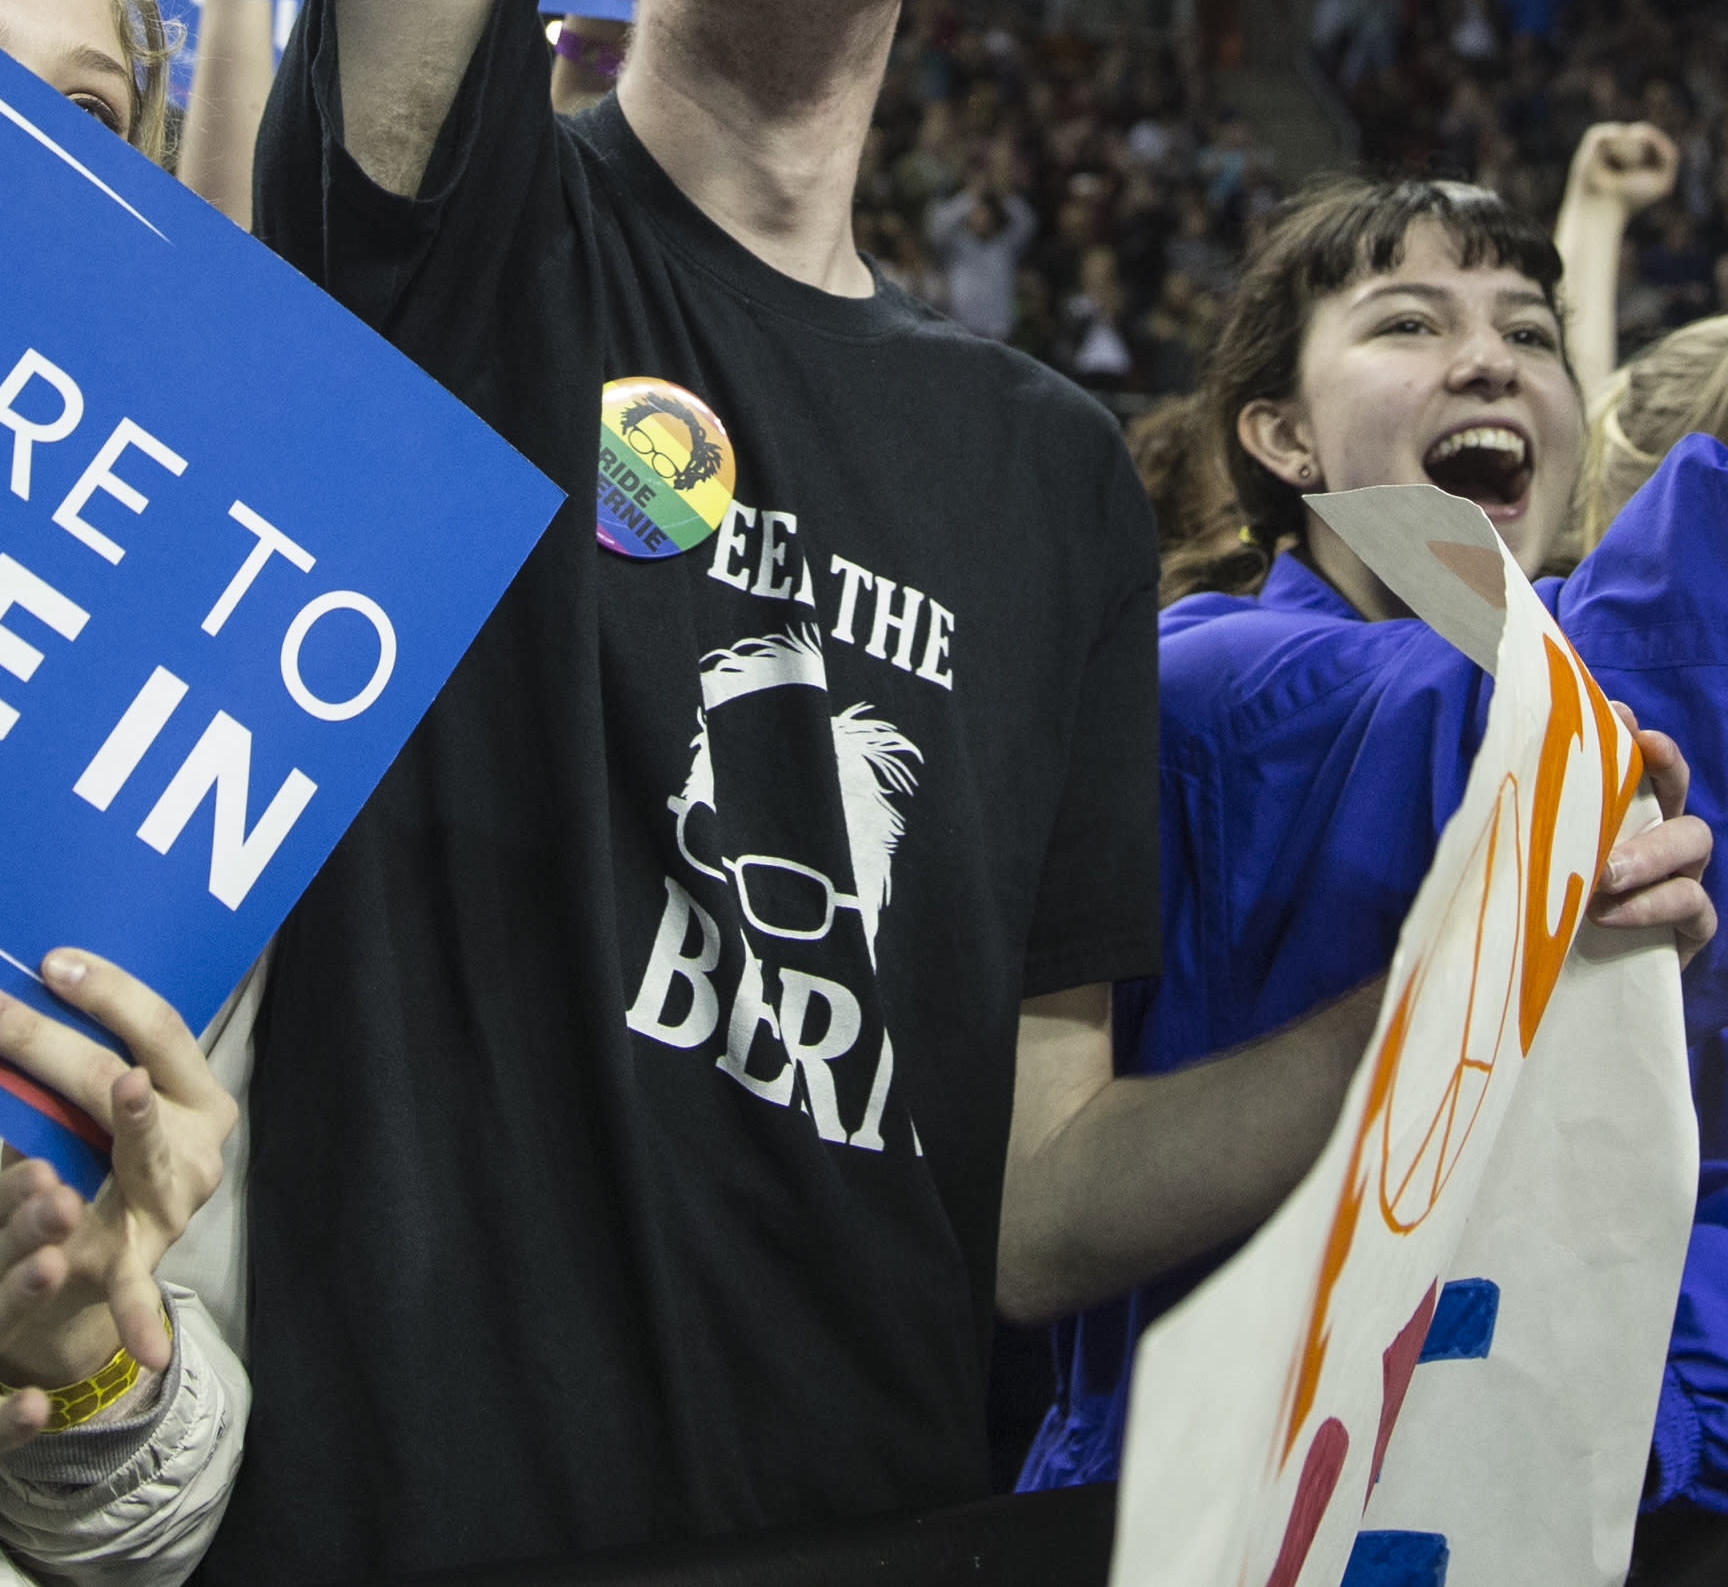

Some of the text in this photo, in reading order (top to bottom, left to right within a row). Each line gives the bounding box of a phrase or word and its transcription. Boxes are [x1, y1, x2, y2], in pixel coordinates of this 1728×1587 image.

[201, 500, 396, 721] TO
[830, 553, 954, 691] THE
[73, 666, 317, 911] IN
